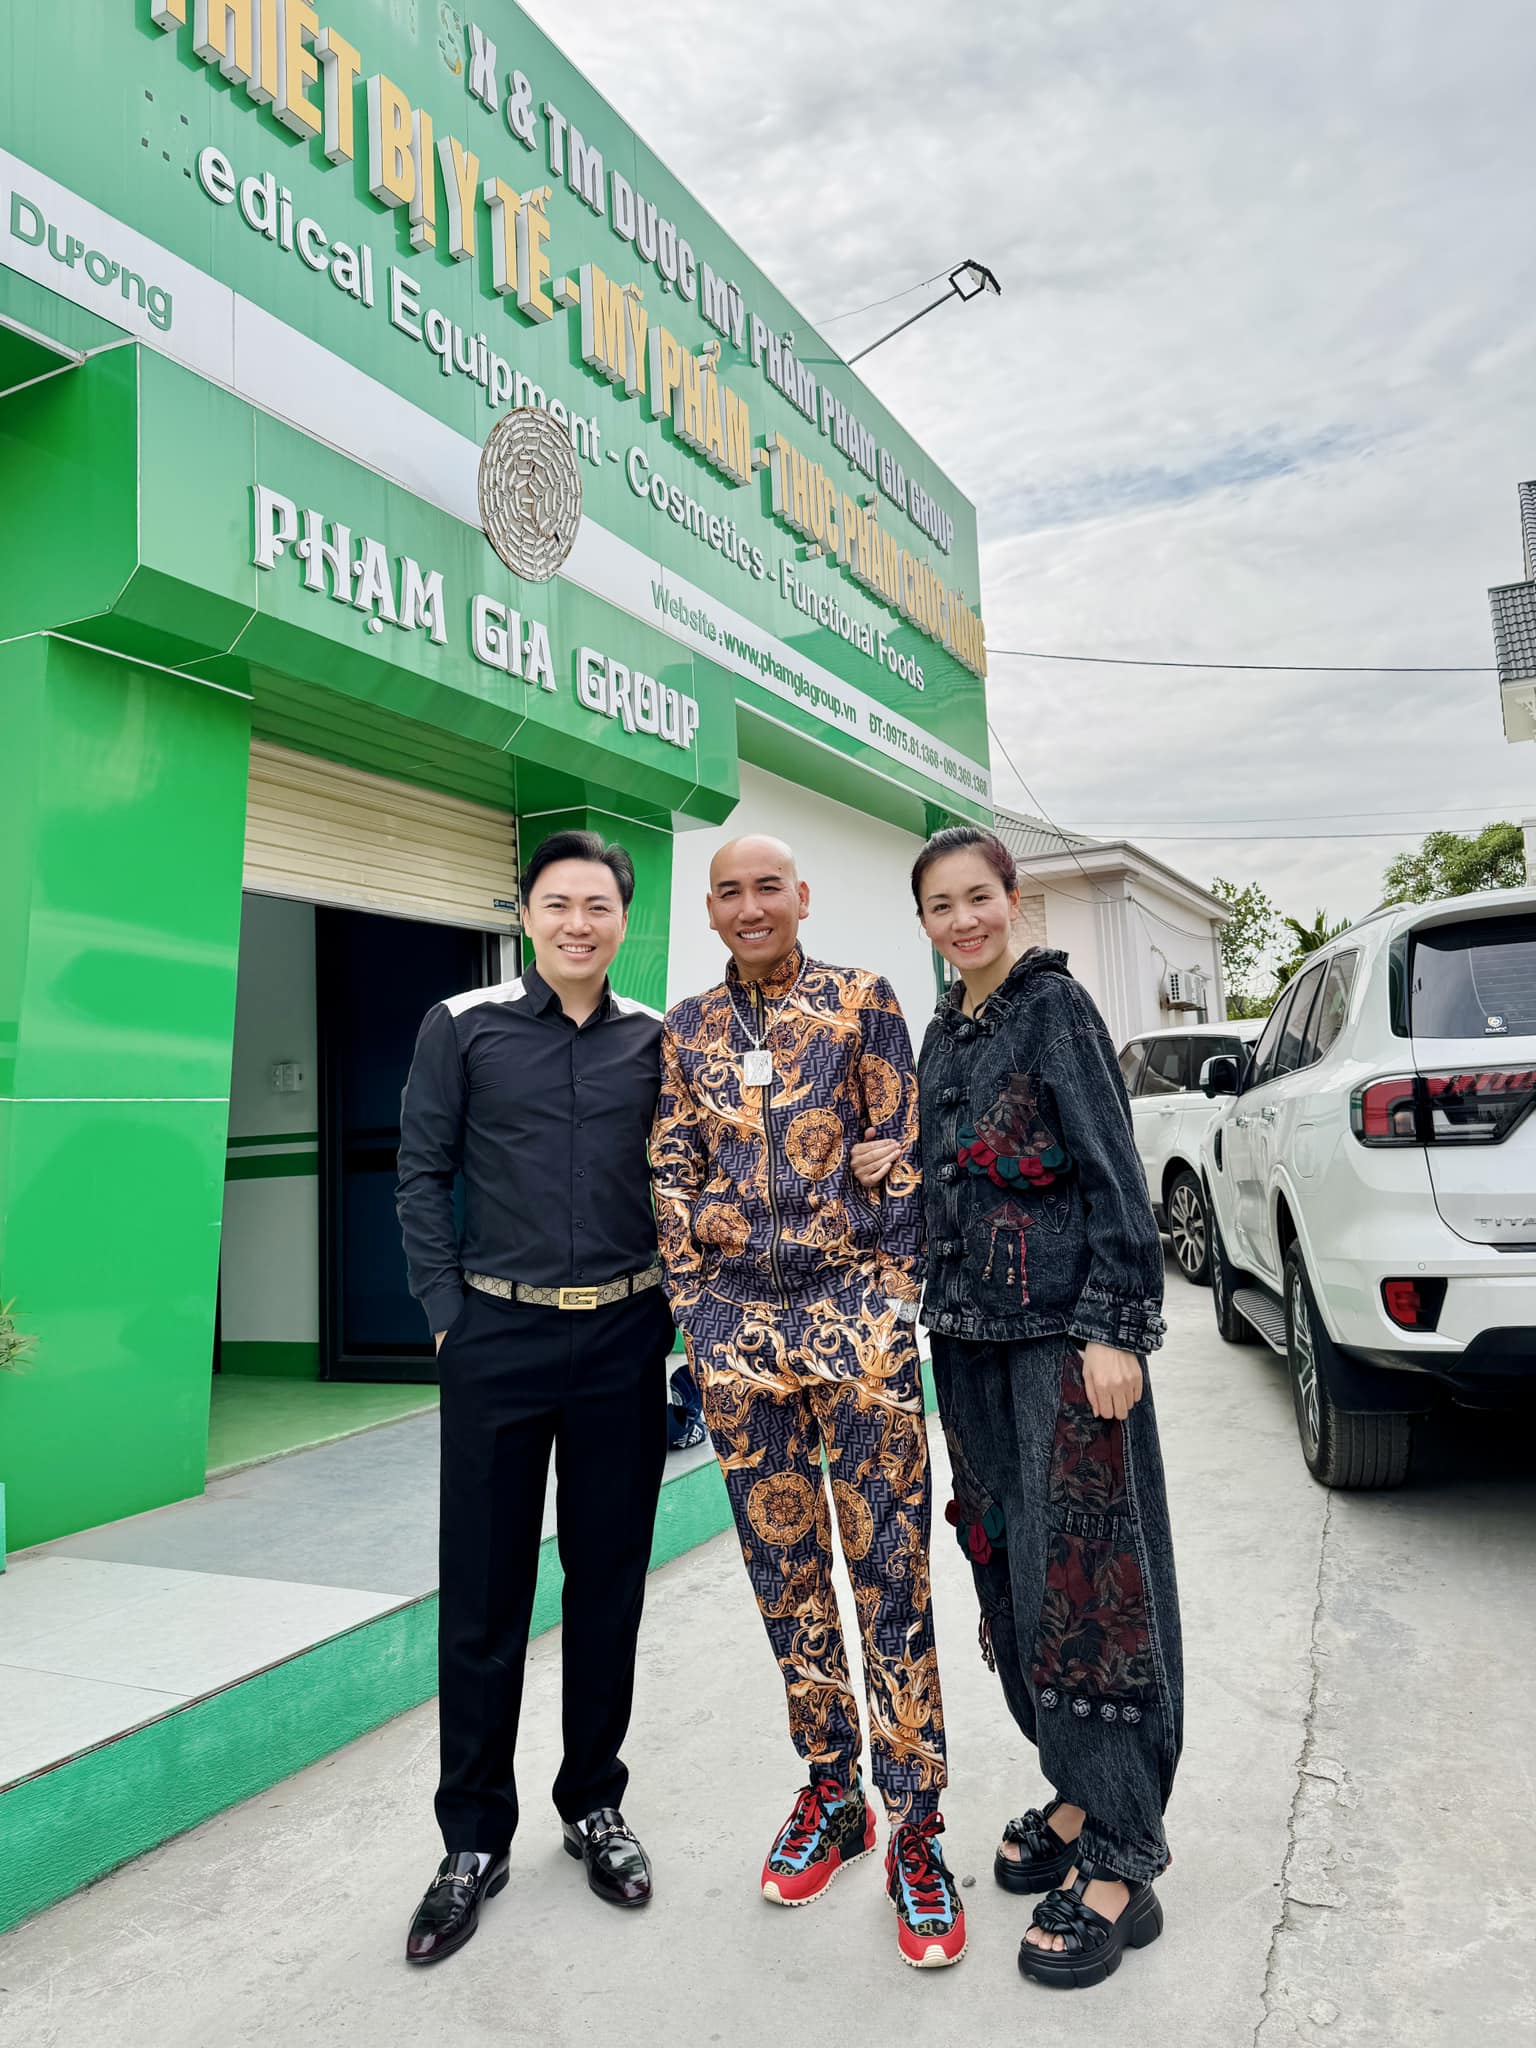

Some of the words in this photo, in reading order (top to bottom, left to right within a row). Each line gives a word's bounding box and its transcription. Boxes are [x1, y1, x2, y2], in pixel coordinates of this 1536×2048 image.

[10, 190, 173, 331] Dương
[199, 147, 374, 308] edical
[628, 446, 764, 580] Cosmetics
[781, 559, 874, 658] Functional
[877, 630, 925, 692] Foods
[366, 74, 436, 252] BỊ
[437, 135, 480, 262] Y
[483, 177, 552, 324] TẾ
[579, 262, 648, 399] MỸ
[648, 324, 752, 487] PHẨM
[766, 430, 838, 560] THỰC
[507, 70, 536, 150] &
[543, 101, 604, 216] TM
[612, 169, 697, 302] DƯỢC
[701, 260, 743, 349] MỸ
[751, 312, 816, 424] PHẨM
[820, 384, 876, 481] PHẠM
[880, 448, 906, 511] GIA
[909, 478, 954, 555] GROUP
[253, 484, 448, 645] PHẠM
[472, 594, 558, 692] GIA
[576, 647, 699, 749] GROUP
